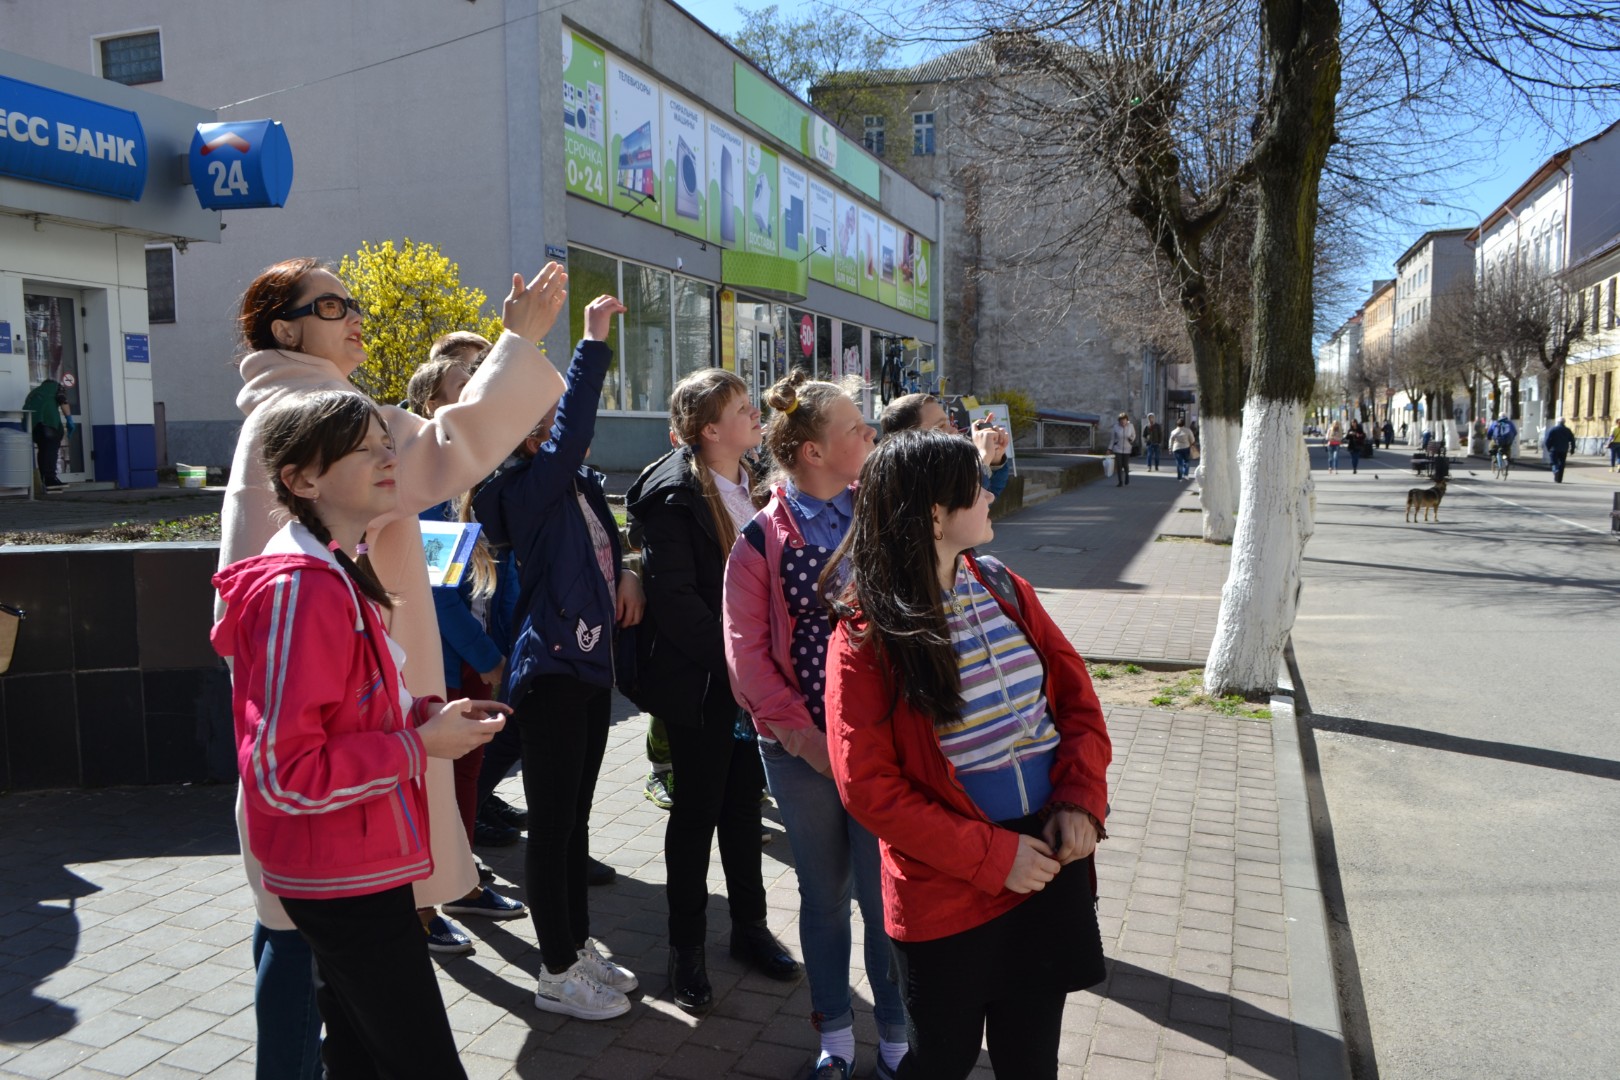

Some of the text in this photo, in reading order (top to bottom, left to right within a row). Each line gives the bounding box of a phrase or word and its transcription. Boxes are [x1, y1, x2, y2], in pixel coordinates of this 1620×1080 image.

[617, 69, 651, 96] ТЕЛЕВИЗОРЫ
[670, 100, 698, 123] СТИРАЛЬНЫЕ
[673, 113, 695, 130] МАШИНЫ
[56, 121, 137, 167] БАНК
[207, 160, 249, 197] 24
